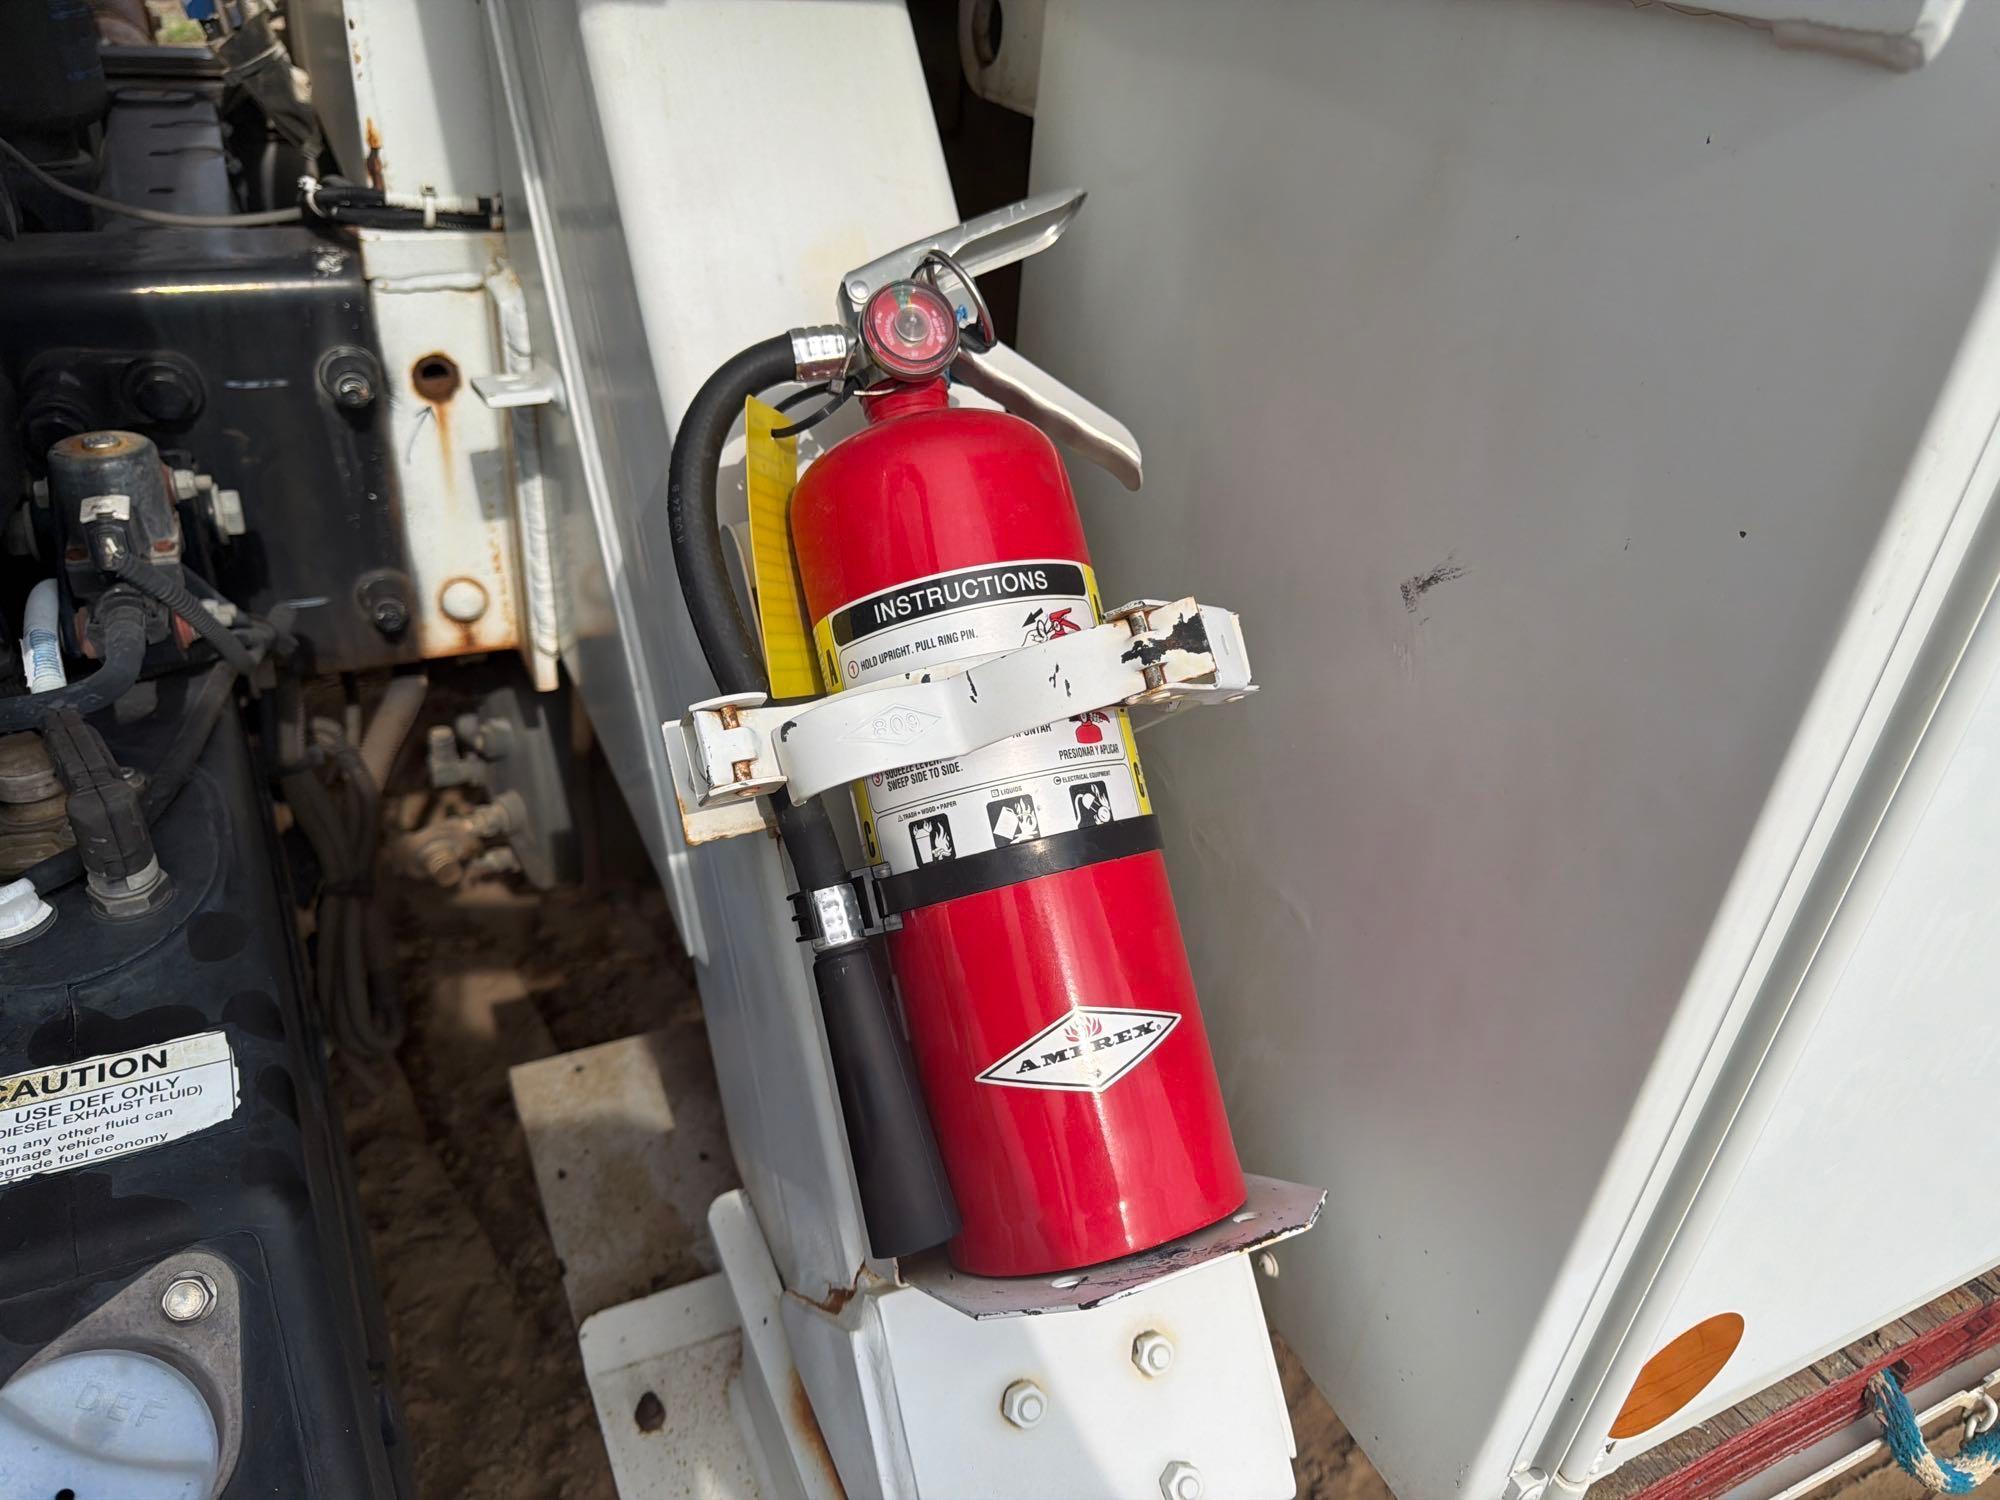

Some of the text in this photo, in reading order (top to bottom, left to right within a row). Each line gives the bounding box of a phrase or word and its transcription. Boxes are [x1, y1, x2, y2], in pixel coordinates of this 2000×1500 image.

[874, 570, 1048, 624] INSTRUCTIONS
[860, 657, 878, 672] HOLD
[879, 645, 914, 663] UPRIGHT.
[915, 639, 936, 653] PULL
[938, 633, 959, 647] RING
[960, 629, 978, 640] PIN.
[1059, 746, 1094, 760] PRESIONAR
[1099, 743, 1119, 755] APLICAR
[887, 761, 964, 792] SWEEP SIDE TO SIDE.
[1000, 785, 1023, 796] LIQUIDS
[1062, 773, 1089, 783] ELECTRICAL
[1090, 770, 1111, 780] EQUIPMENT
[903, 811, 917, 820] TRASH
[921, 806, 936, 815] WOOD
[940, 800, 957, 810] PAPER
[15, 1076, 180, 1124] USE DEF ONLY
[63, 1099, 142, 1125] EXHAUST
[150, 1085, 203, 1105] FLUID)
[23, 1136, 52, 1149] any
[57, 1125, 100, 1141] other
[105, 1115, 139, 1130] fluid
[145, 1109, 173, 1121] can
[57, 1133, 115, 1152] vehicle
[58, 1150, 88, 1164] fuel
[94, 1133, 168, 1155] economy
